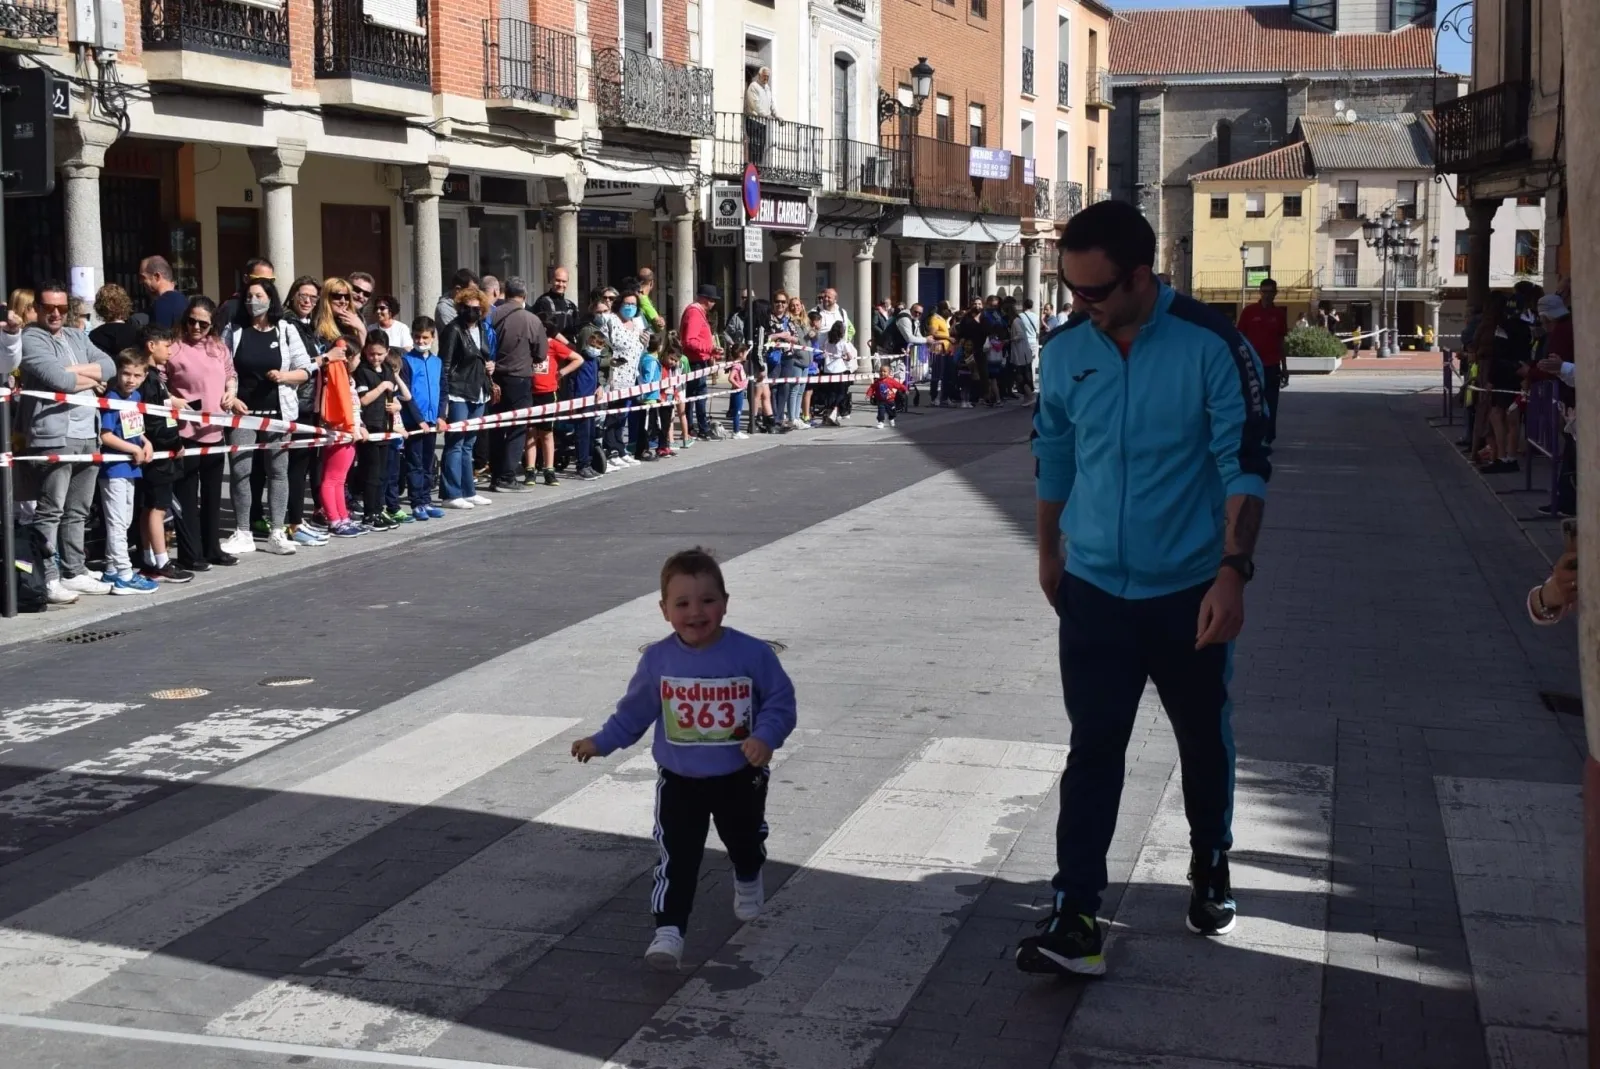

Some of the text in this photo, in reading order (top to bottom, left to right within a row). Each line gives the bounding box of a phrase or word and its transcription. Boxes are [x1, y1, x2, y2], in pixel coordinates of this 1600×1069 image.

[715, 217, 742, 227] CARRERA
[776, 200, 807, 225] CARRERA
[662, 680, 750, 702] bedunia
[677, 702, 735, 728] 363
